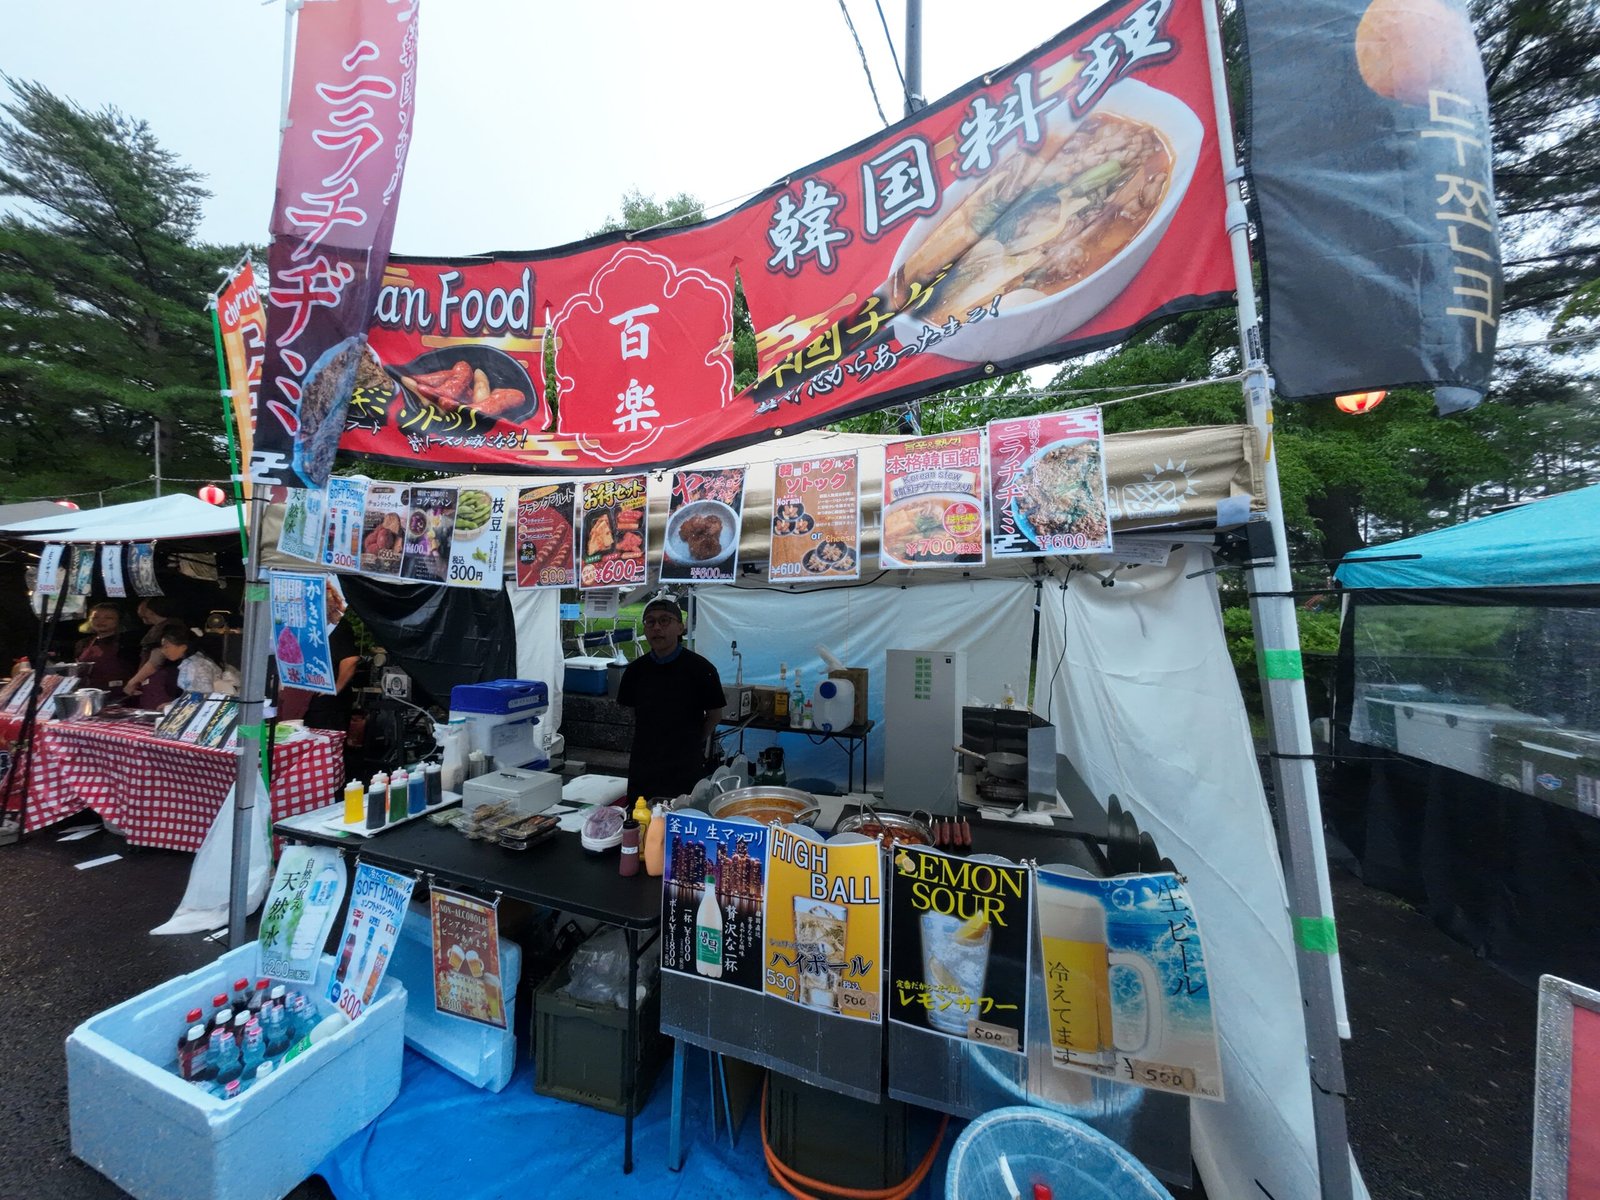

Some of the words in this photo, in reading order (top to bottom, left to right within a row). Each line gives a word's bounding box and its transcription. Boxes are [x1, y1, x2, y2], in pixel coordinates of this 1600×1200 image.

[767, 0, 1174, 269] 韓国料理
[266, 40, 397, 437] ニラチヂミ
[223, 281, 260, 328] churro
[374, 284, 431, 331] an
[438, 267, 532, 332] Food
[608, 303, 661, 433] 百楽
[886, 447, 981, 475] 本格韓国鍋
[786, 473, 847, 494] ソトック
[903, 471, 936, 484] Korean
[937, 471, 963, 481] stew
[994, 424, 1028, 535] ニラチヂミ
[416, 497, 452, 507] コグマパン
[518, 487, 576, 517] フランクフルト
[583, 479, 646, 511] お得セット
[776, 496, 802, 506] Normal
[489, 497, 505, 532] 枝豆
[811, 532, 822, 540] or
[825, 534, 856, 543] Cheese
[1037, 533, 1086, 551] ¥600
[450, 565, 483, 582] 300円
[452, 556, 465, 565] 税込
[771, 562, 801, 575] ¥600
[306, 580, 326, 649] かき氷
[669, 817, 698, 836] 釜山
[705, 823, 765, 847] 生マッコリ
[772, 829, 828, 873] HIGH
[289, 857, 315, 911] 自然の恵み
[810, 872, 881, 905] BALL
[897, 848, 1025, 899] LEMON
[264, 871, 301, 949] 天然水
[356, 879, 380, 898] SOFT
[380, 885, 407, 913] DRINK
[669, 898, 678, 923] ボトル
[911, 882, 1009, 927] SOUR
[441, 917, 488, 939] ノンアルコール
[684, 908, 693, 924] 一杯
[441, 929, 489, 951] ビールあります
[668, 923, 677, 967] ¥1800
[683, 926, 692, 962] ¥600
[700, 930, 719, 954] 생탁
[724, 904, 739, 973] 贅沢な一杯
[1157, 879, 1205, 997] 生ビール
[770, 952, 874, 977] ハイボール
[766, 968, 797, 992] 530
[843, 993, 867, 1007] 500
[898, 988, 1019, 1014] レモンサワー
[1048, 960, 1078, 1066] 冷えてます
[974, 1026, 1003, 1042] 500
